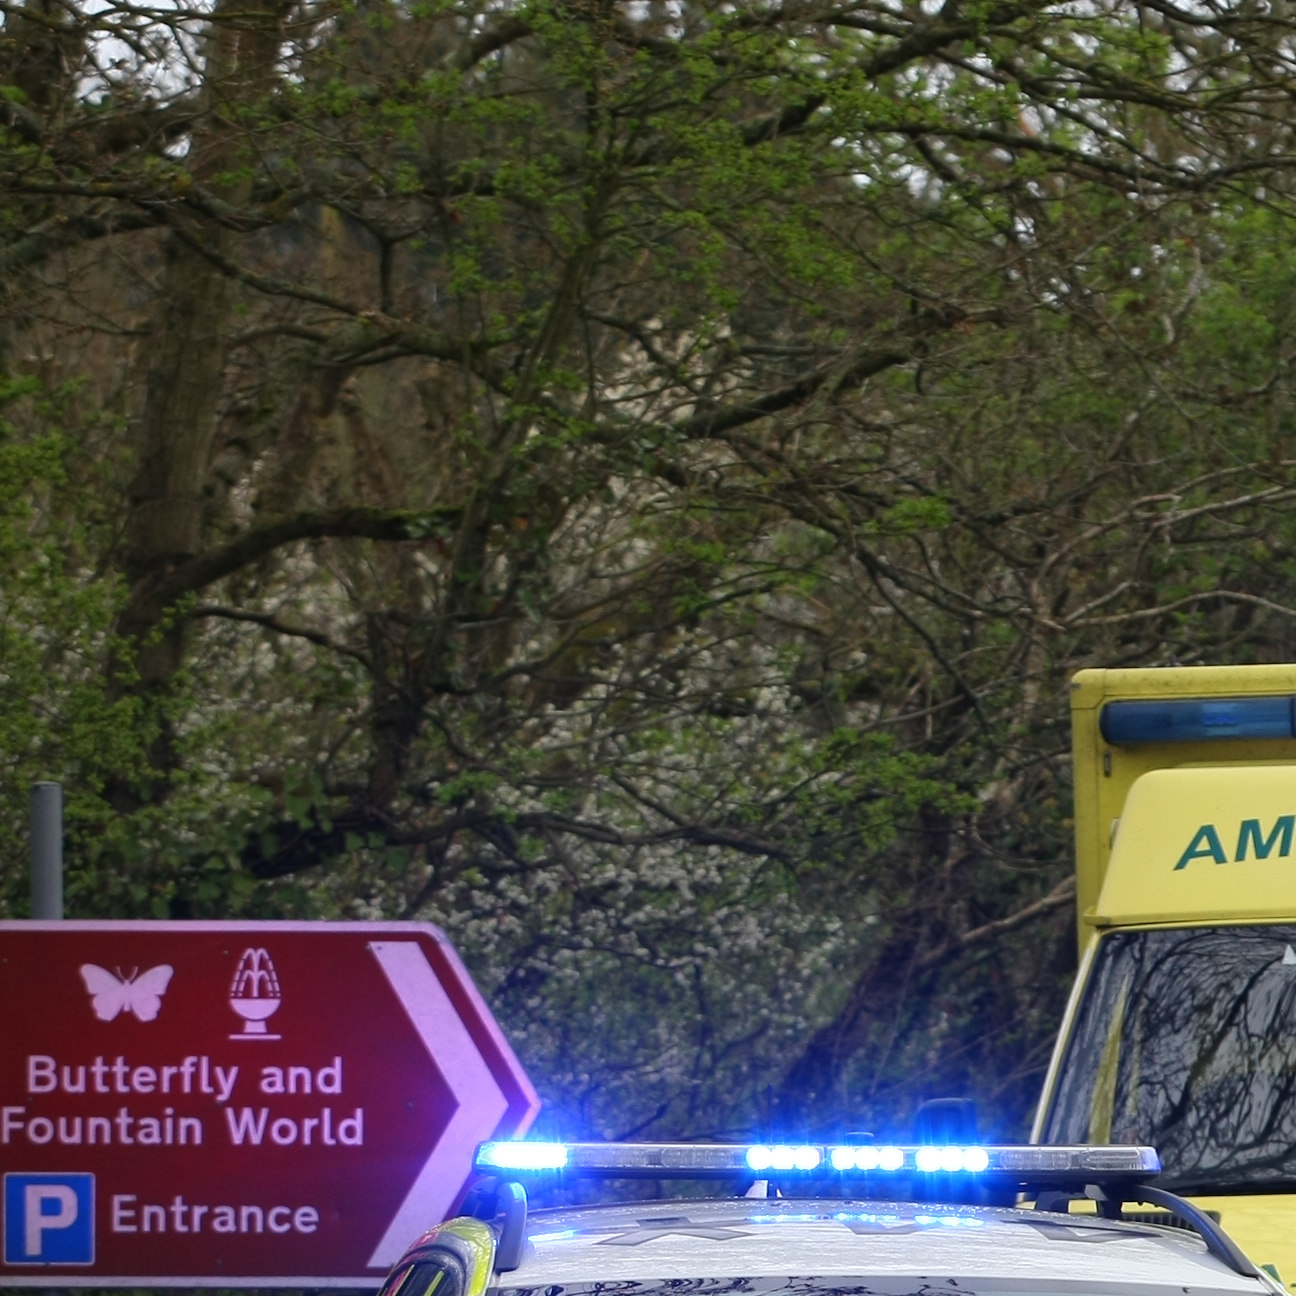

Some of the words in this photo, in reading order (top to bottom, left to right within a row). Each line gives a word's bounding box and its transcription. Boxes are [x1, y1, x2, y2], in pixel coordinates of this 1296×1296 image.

[27, 1056, 239, 1101] Butterfly
[260, 1056, 342, 1094] and
[1, 1107, 203, 1146] Fountain
[226, 1108, 364, 1146] World
[25, 1185, 78, 1256] P
[112, 1195, 319, 1234] Entrance
